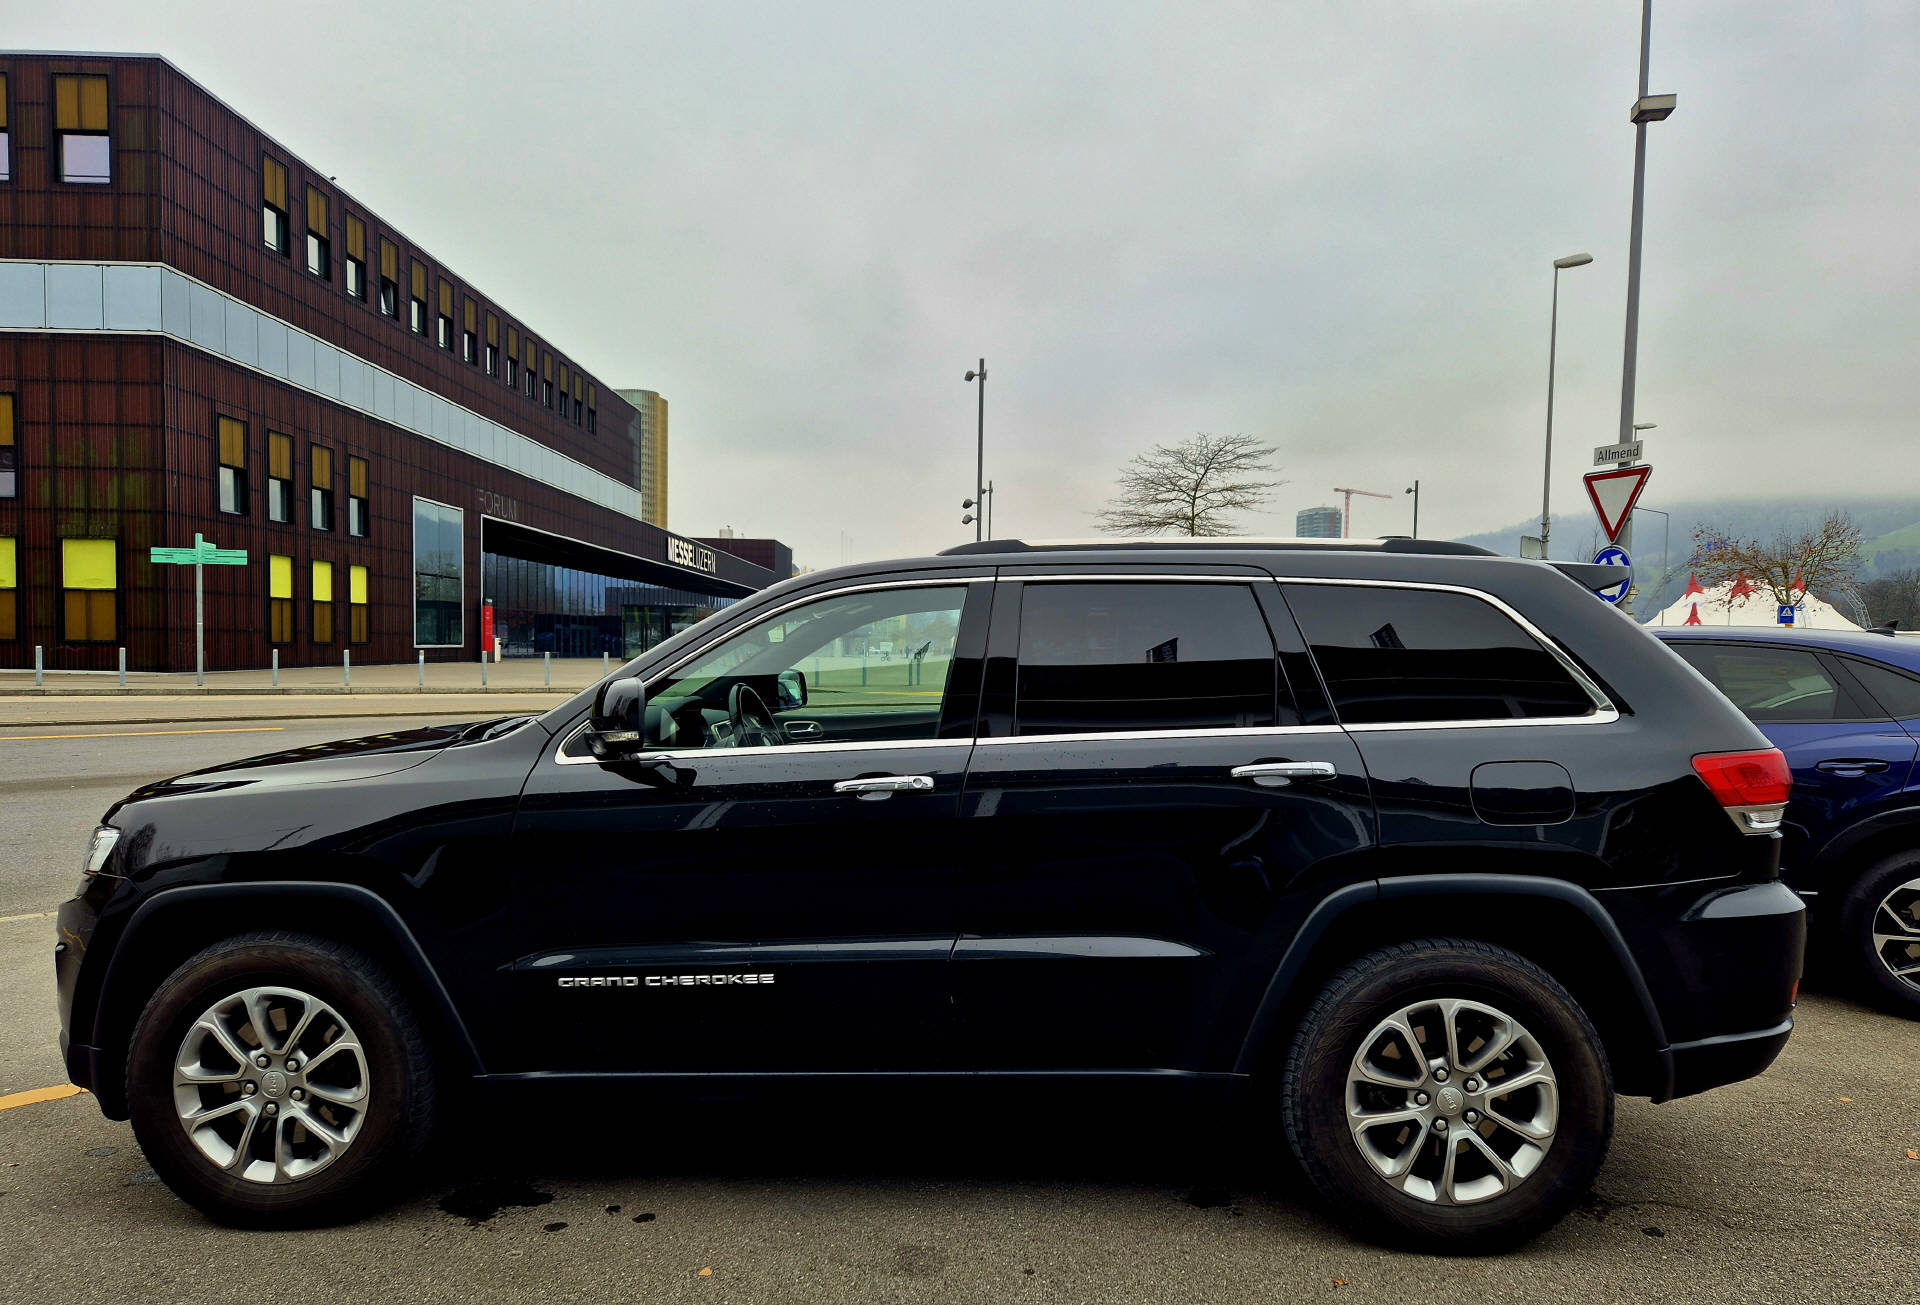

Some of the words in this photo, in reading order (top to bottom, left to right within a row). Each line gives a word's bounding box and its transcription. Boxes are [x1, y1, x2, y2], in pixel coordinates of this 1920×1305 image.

[1597, 444, 1640, 462] Allmend
[477, 488, 518, 520] FORUM
[558, 976, 639, 987] GRAND
[645, 973, 775, 986] CHEROKEE
